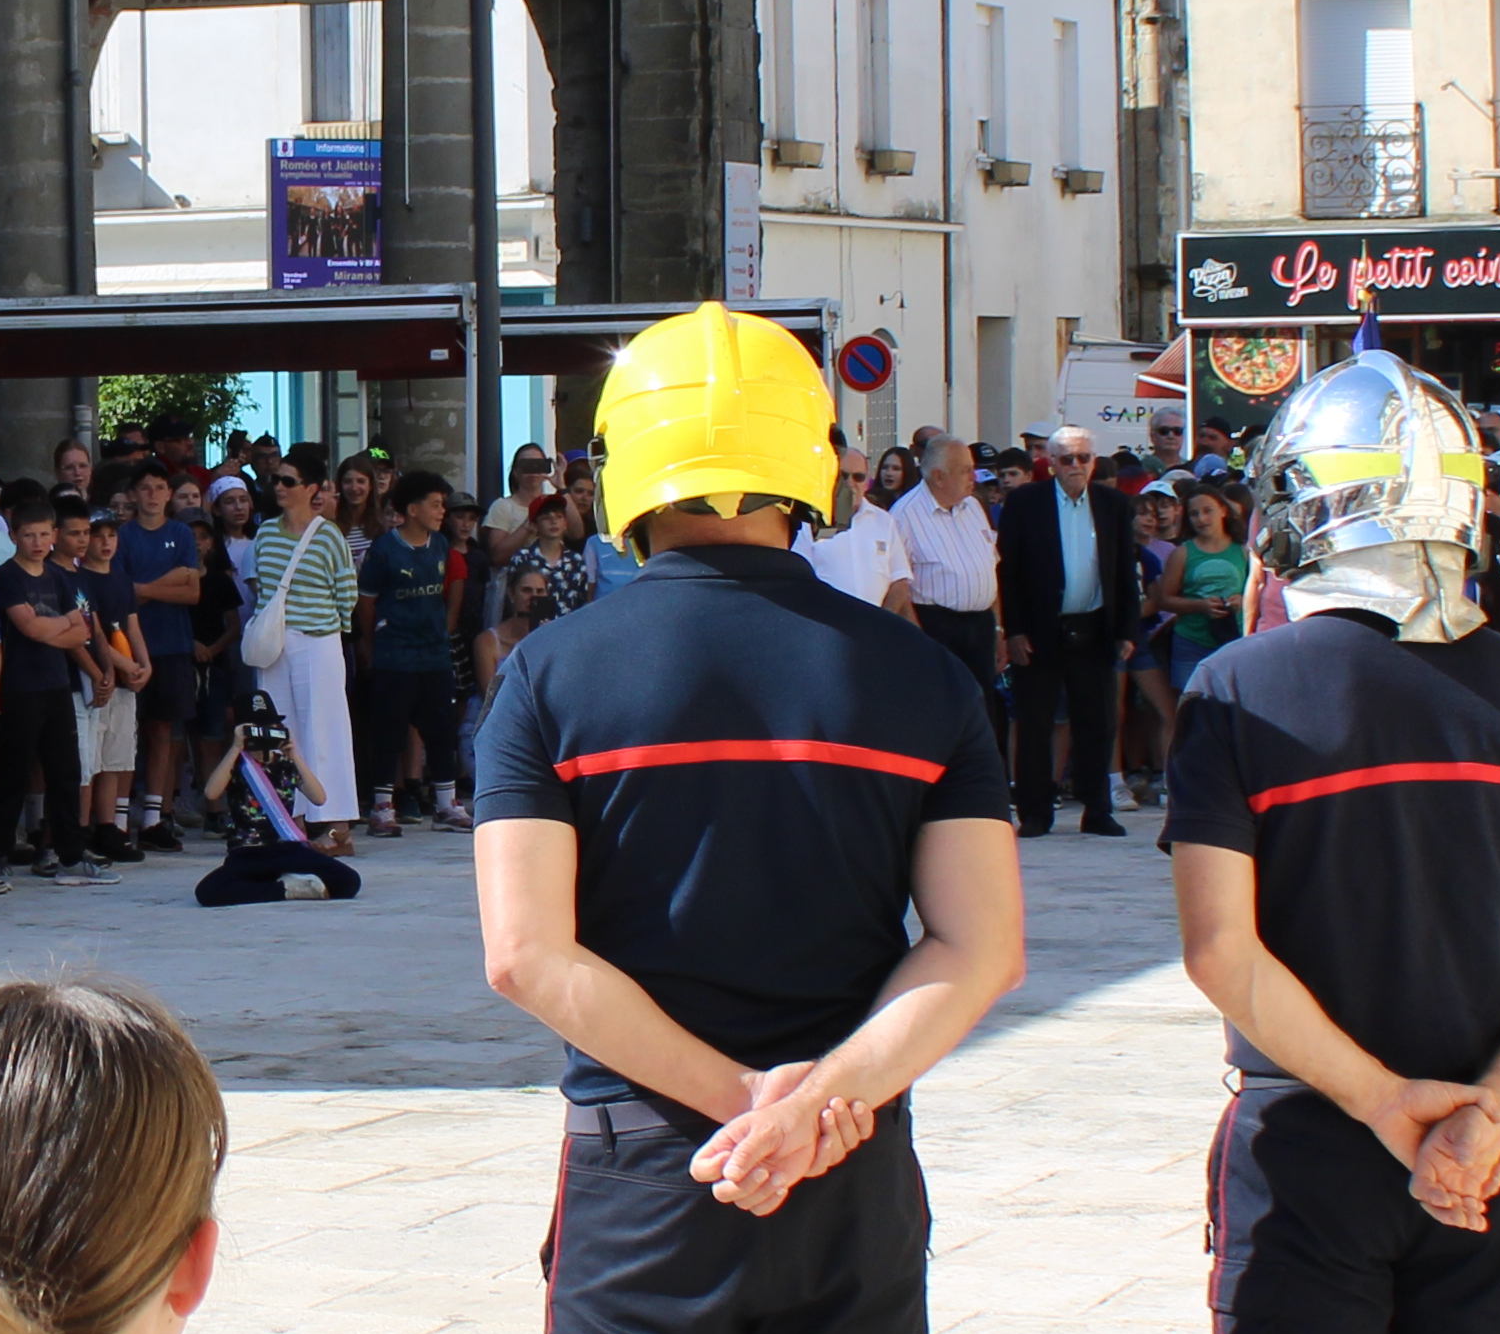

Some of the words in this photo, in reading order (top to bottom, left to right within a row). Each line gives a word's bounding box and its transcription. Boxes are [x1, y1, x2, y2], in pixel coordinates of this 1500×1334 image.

[315, 143, 365, 154] Informations
[280, 159, 317, 171] Roméo
[321, 161, 333, 171] et
[335, 159, 375, 171] Juliette
[1271, 240, 1337, 307] Le
[1347, 246, 1435, 310] petit
